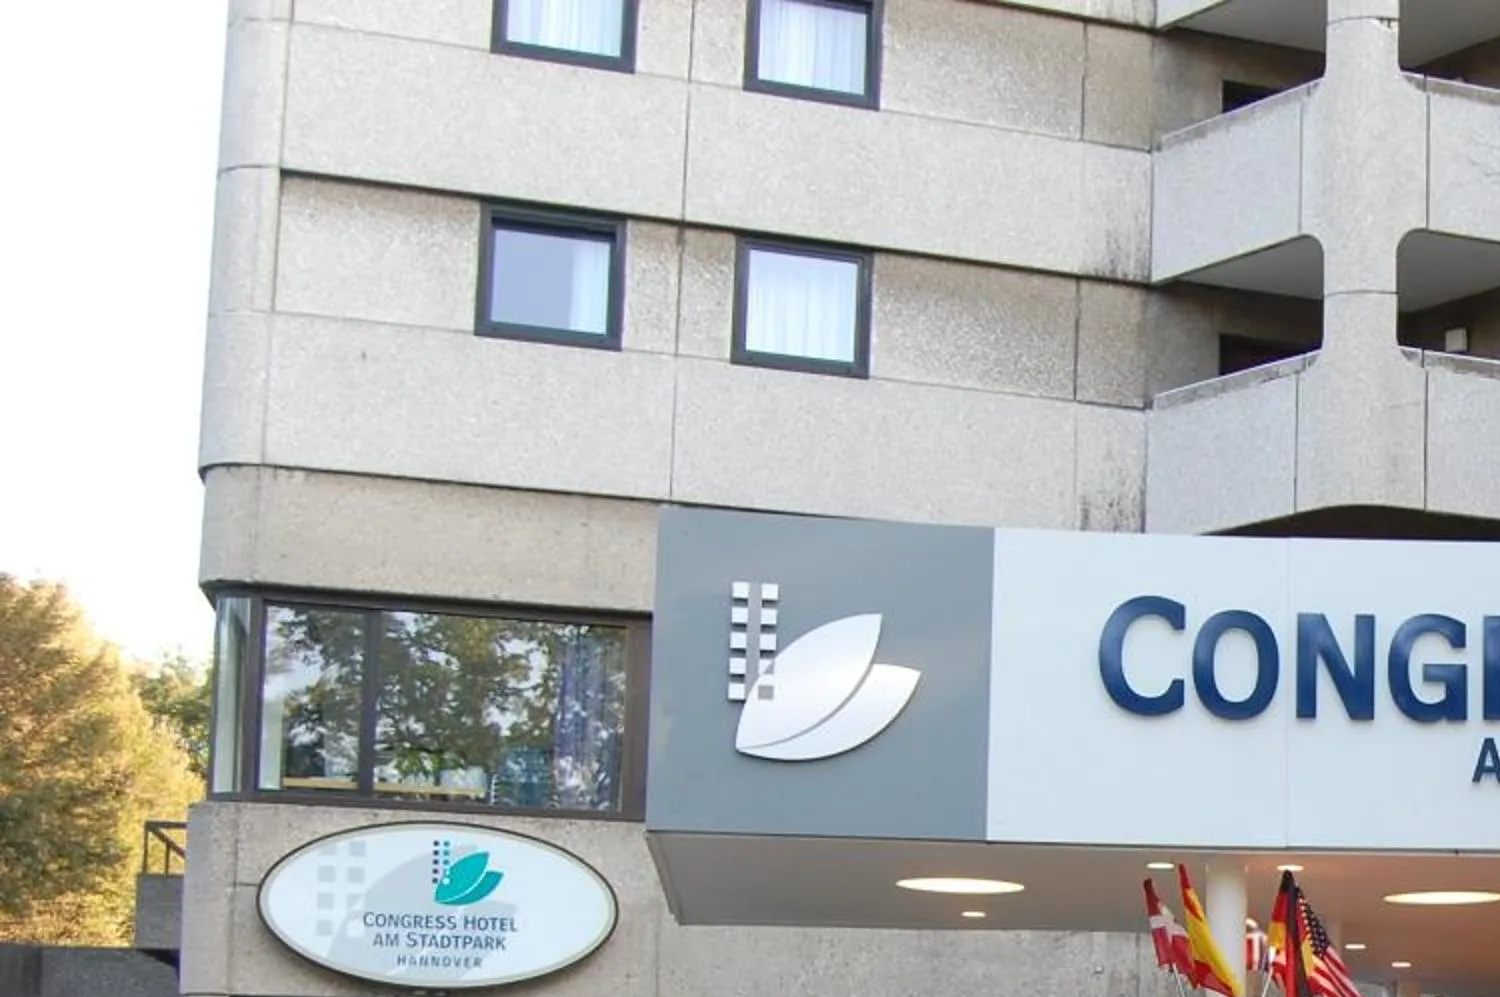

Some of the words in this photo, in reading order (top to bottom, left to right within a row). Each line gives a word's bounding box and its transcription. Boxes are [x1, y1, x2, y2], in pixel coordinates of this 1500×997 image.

[363, 912, 457, 930] CONGRESS
[463, 915, 518, 932] HOTEL
[373, 933, 399, 947] AM
[405, 931, 506, 950] STADTPARK
[397, 954, 483, 968] HANNOVER
